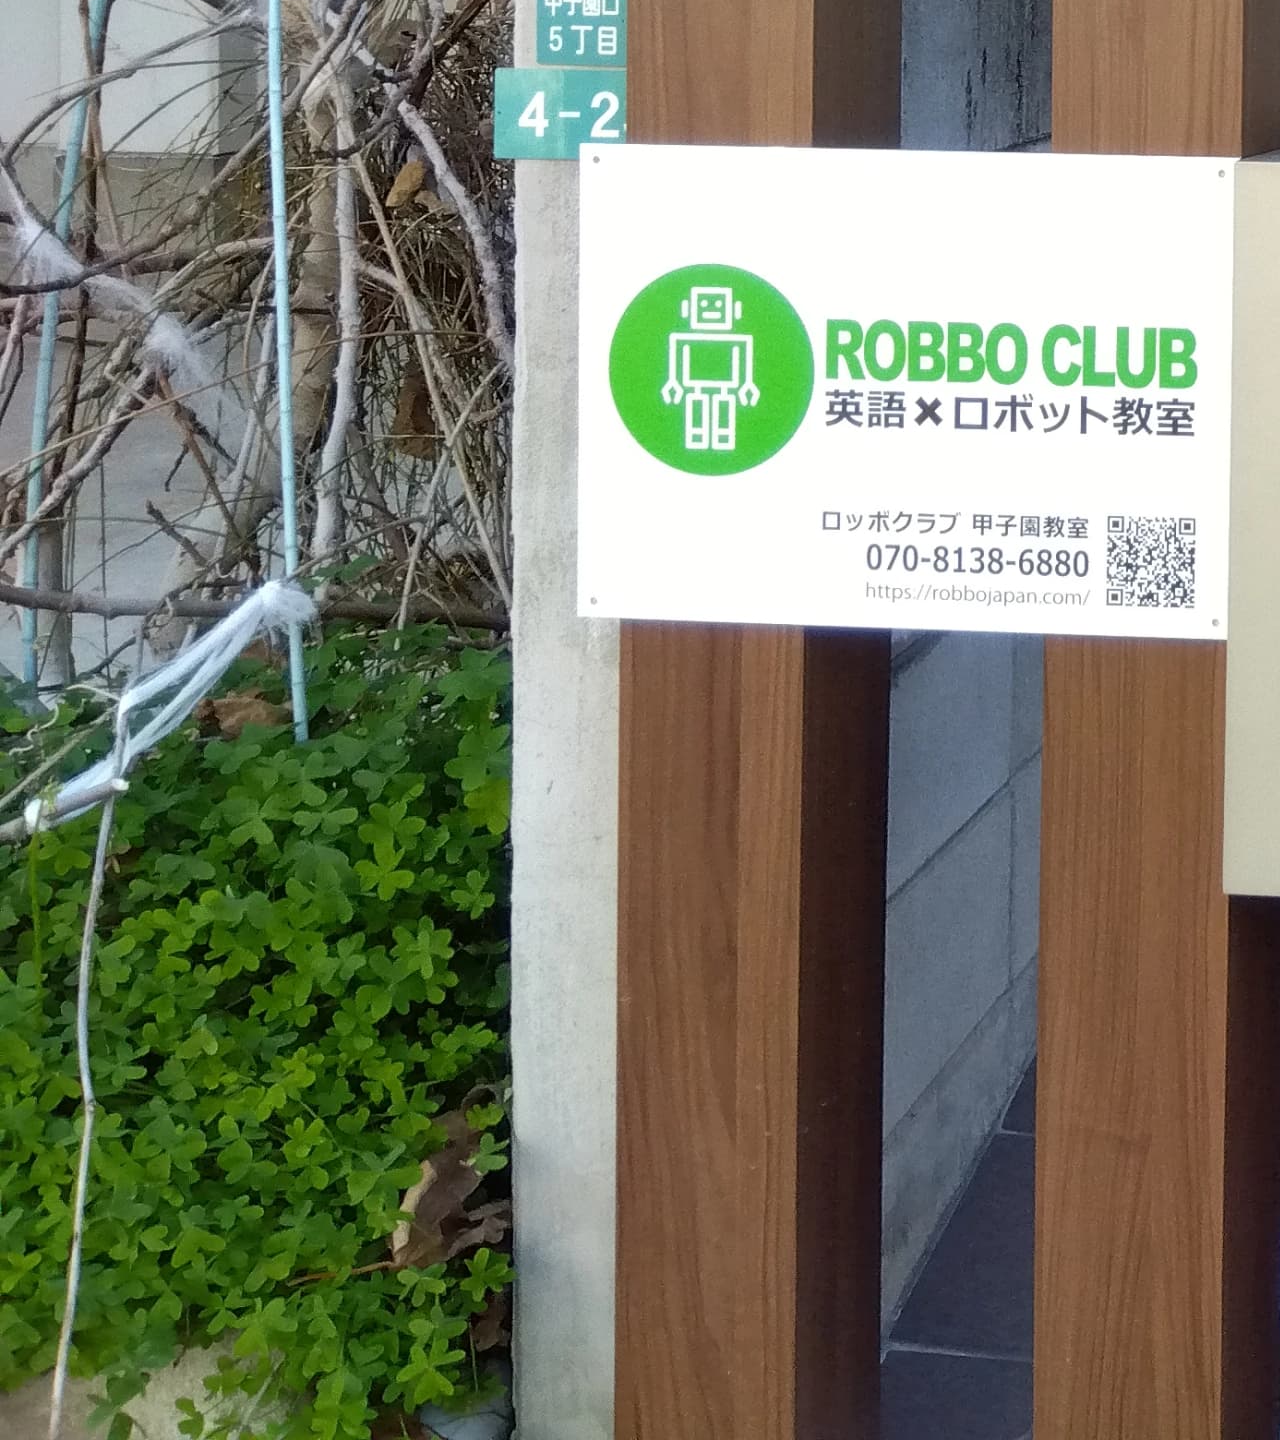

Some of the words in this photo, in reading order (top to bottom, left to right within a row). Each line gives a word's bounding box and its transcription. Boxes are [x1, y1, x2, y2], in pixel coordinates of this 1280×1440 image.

[549, 25, 618, 55] 5丁目
[518, 91, 627, 138] 4-2
[825, 319, 1028, 386] ROBBO
[1041, 324, 1198, 389] CLUB
[972, 514, 1089, 539] 甲子園教室
[866, 543, 1090, 578] 070-8138-6880
[865, 582, 1091, 607] https://robbojapan.com/
